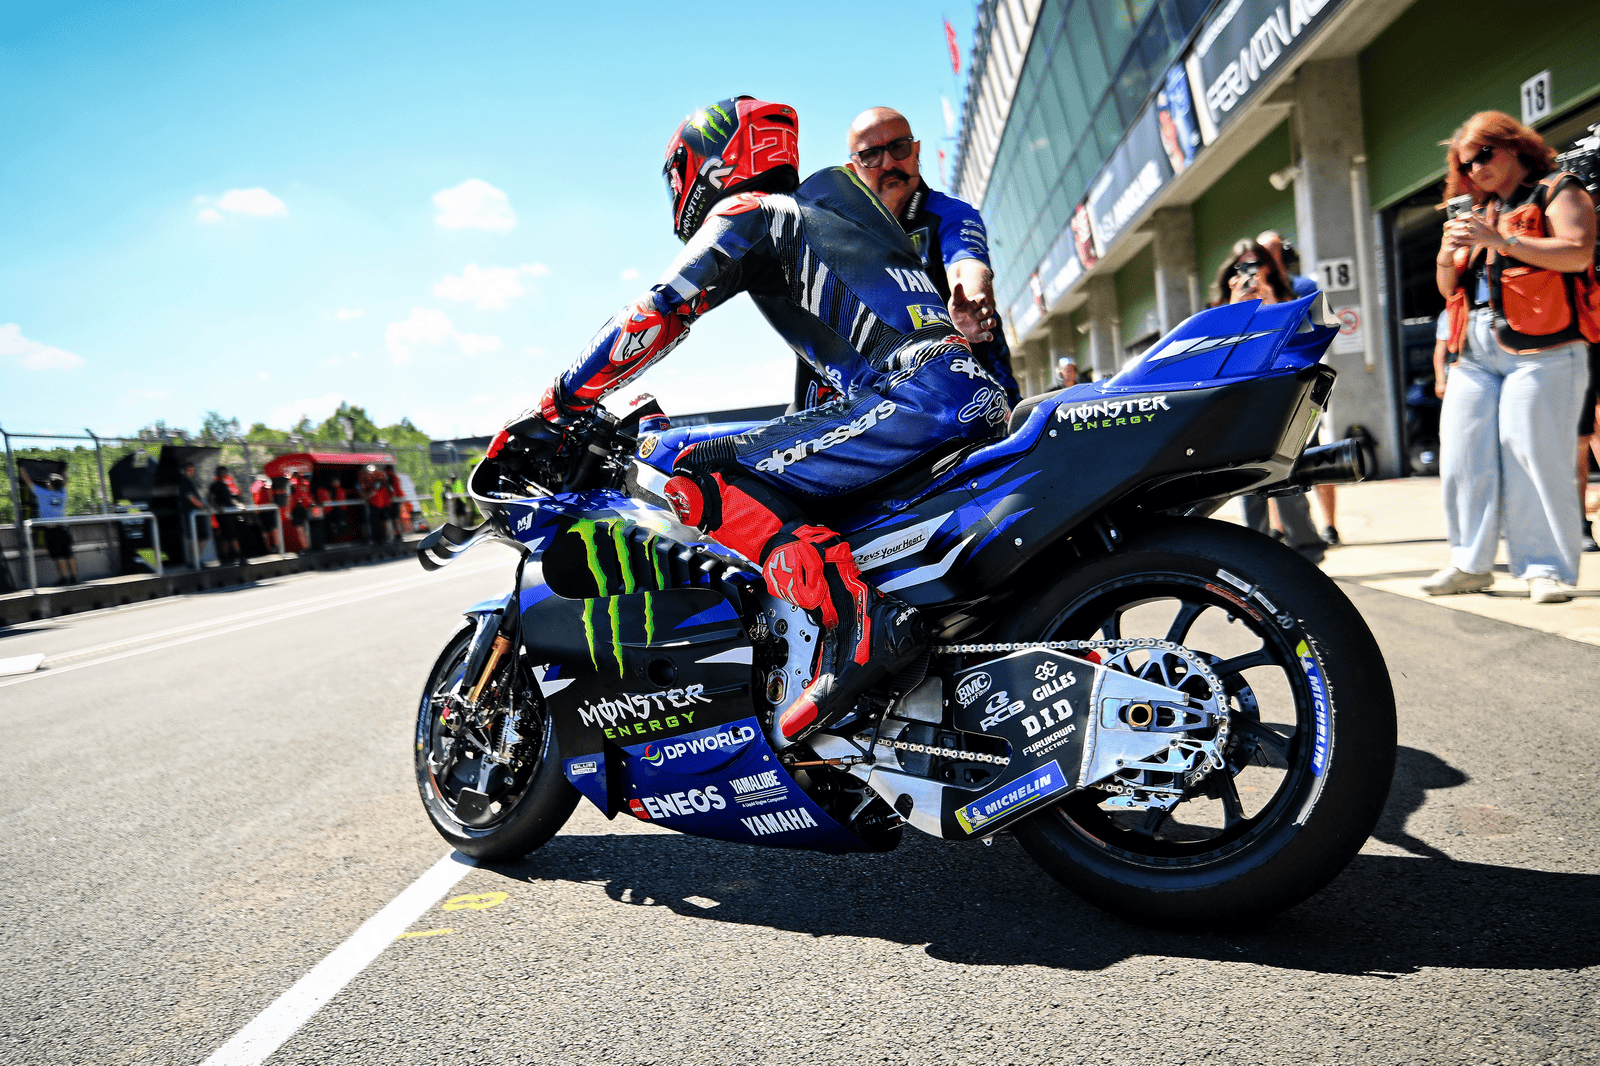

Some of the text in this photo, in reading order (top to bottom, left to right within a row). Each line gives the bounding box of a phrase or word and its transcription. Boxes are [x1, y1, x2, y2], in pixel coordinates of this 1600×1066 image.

[1524, 80, 1545, 116] 18
[1325, 264, 1350, 286] 18
[1055, 395, 1171, 424] MONSTER
[1073, 413, 1155, 431] ENERGY
[755, 399, 897, 475] alpinestars
[881, 543, 902, 559] Your
[903, 534, 926, 548] Heart
[957, 674, 988, 702] BMC
[1032, 671, 1077, 701] GILLES
[577, 684, 713, 728] MONSTER
[980, 700, 1026, 732] RCB
[1021, 699, 1073, 737] D.I.D
[603, 711, 695, 739] ENERGY
[1308, 675, 1327, 769] MICHELIN
[687, 726, 755, 755] WORLD
[1022, 724, 1076, 757] FURUKAWA
[1036, 737, 1070, 757] ELECTRIC
[729, 769, 781, 795] YAMALUBE
[985, 774, 1051, 814] MICHELIN
[642, 785, 726, 819] ENEOS
[740, 807, 818, 836] YAMAHA
